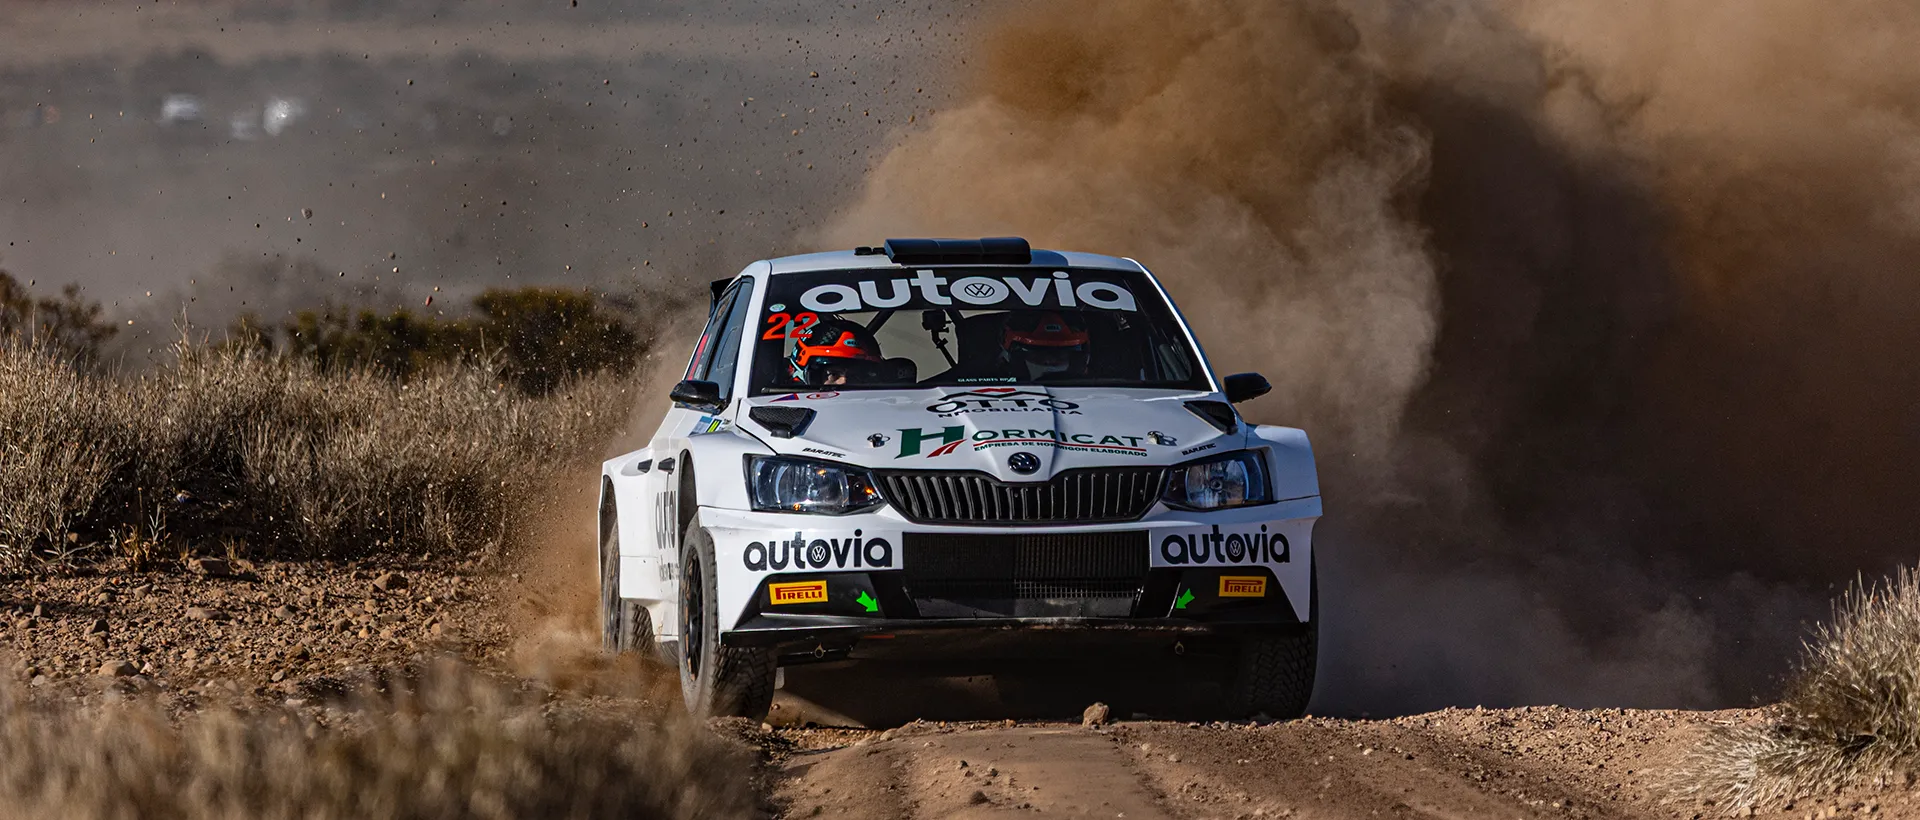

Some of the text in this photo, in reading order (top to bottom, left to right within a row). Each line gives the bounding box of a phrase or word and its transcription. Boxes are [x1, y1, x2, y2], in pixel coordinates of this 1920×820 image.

[800, 270, 1137, 312] autovia
[762, 312, 819, 340] 22
[926, 399, 1079, 413] OTTO
[894, 425, 1143, 459] HORMICAT
[974, 441, 1020, 451] EMPRESA
[1038, 441, 1088, 452] HORMIGON
[1090, 447, 1148, 457] ELABORADO
[743, 529, 893, 571] autovia
[1161, 525, 1290, 565] autovia
[775, 585, 824, 601] PIRELLI
[1224, 580, 1263, 593] PIRELLI
